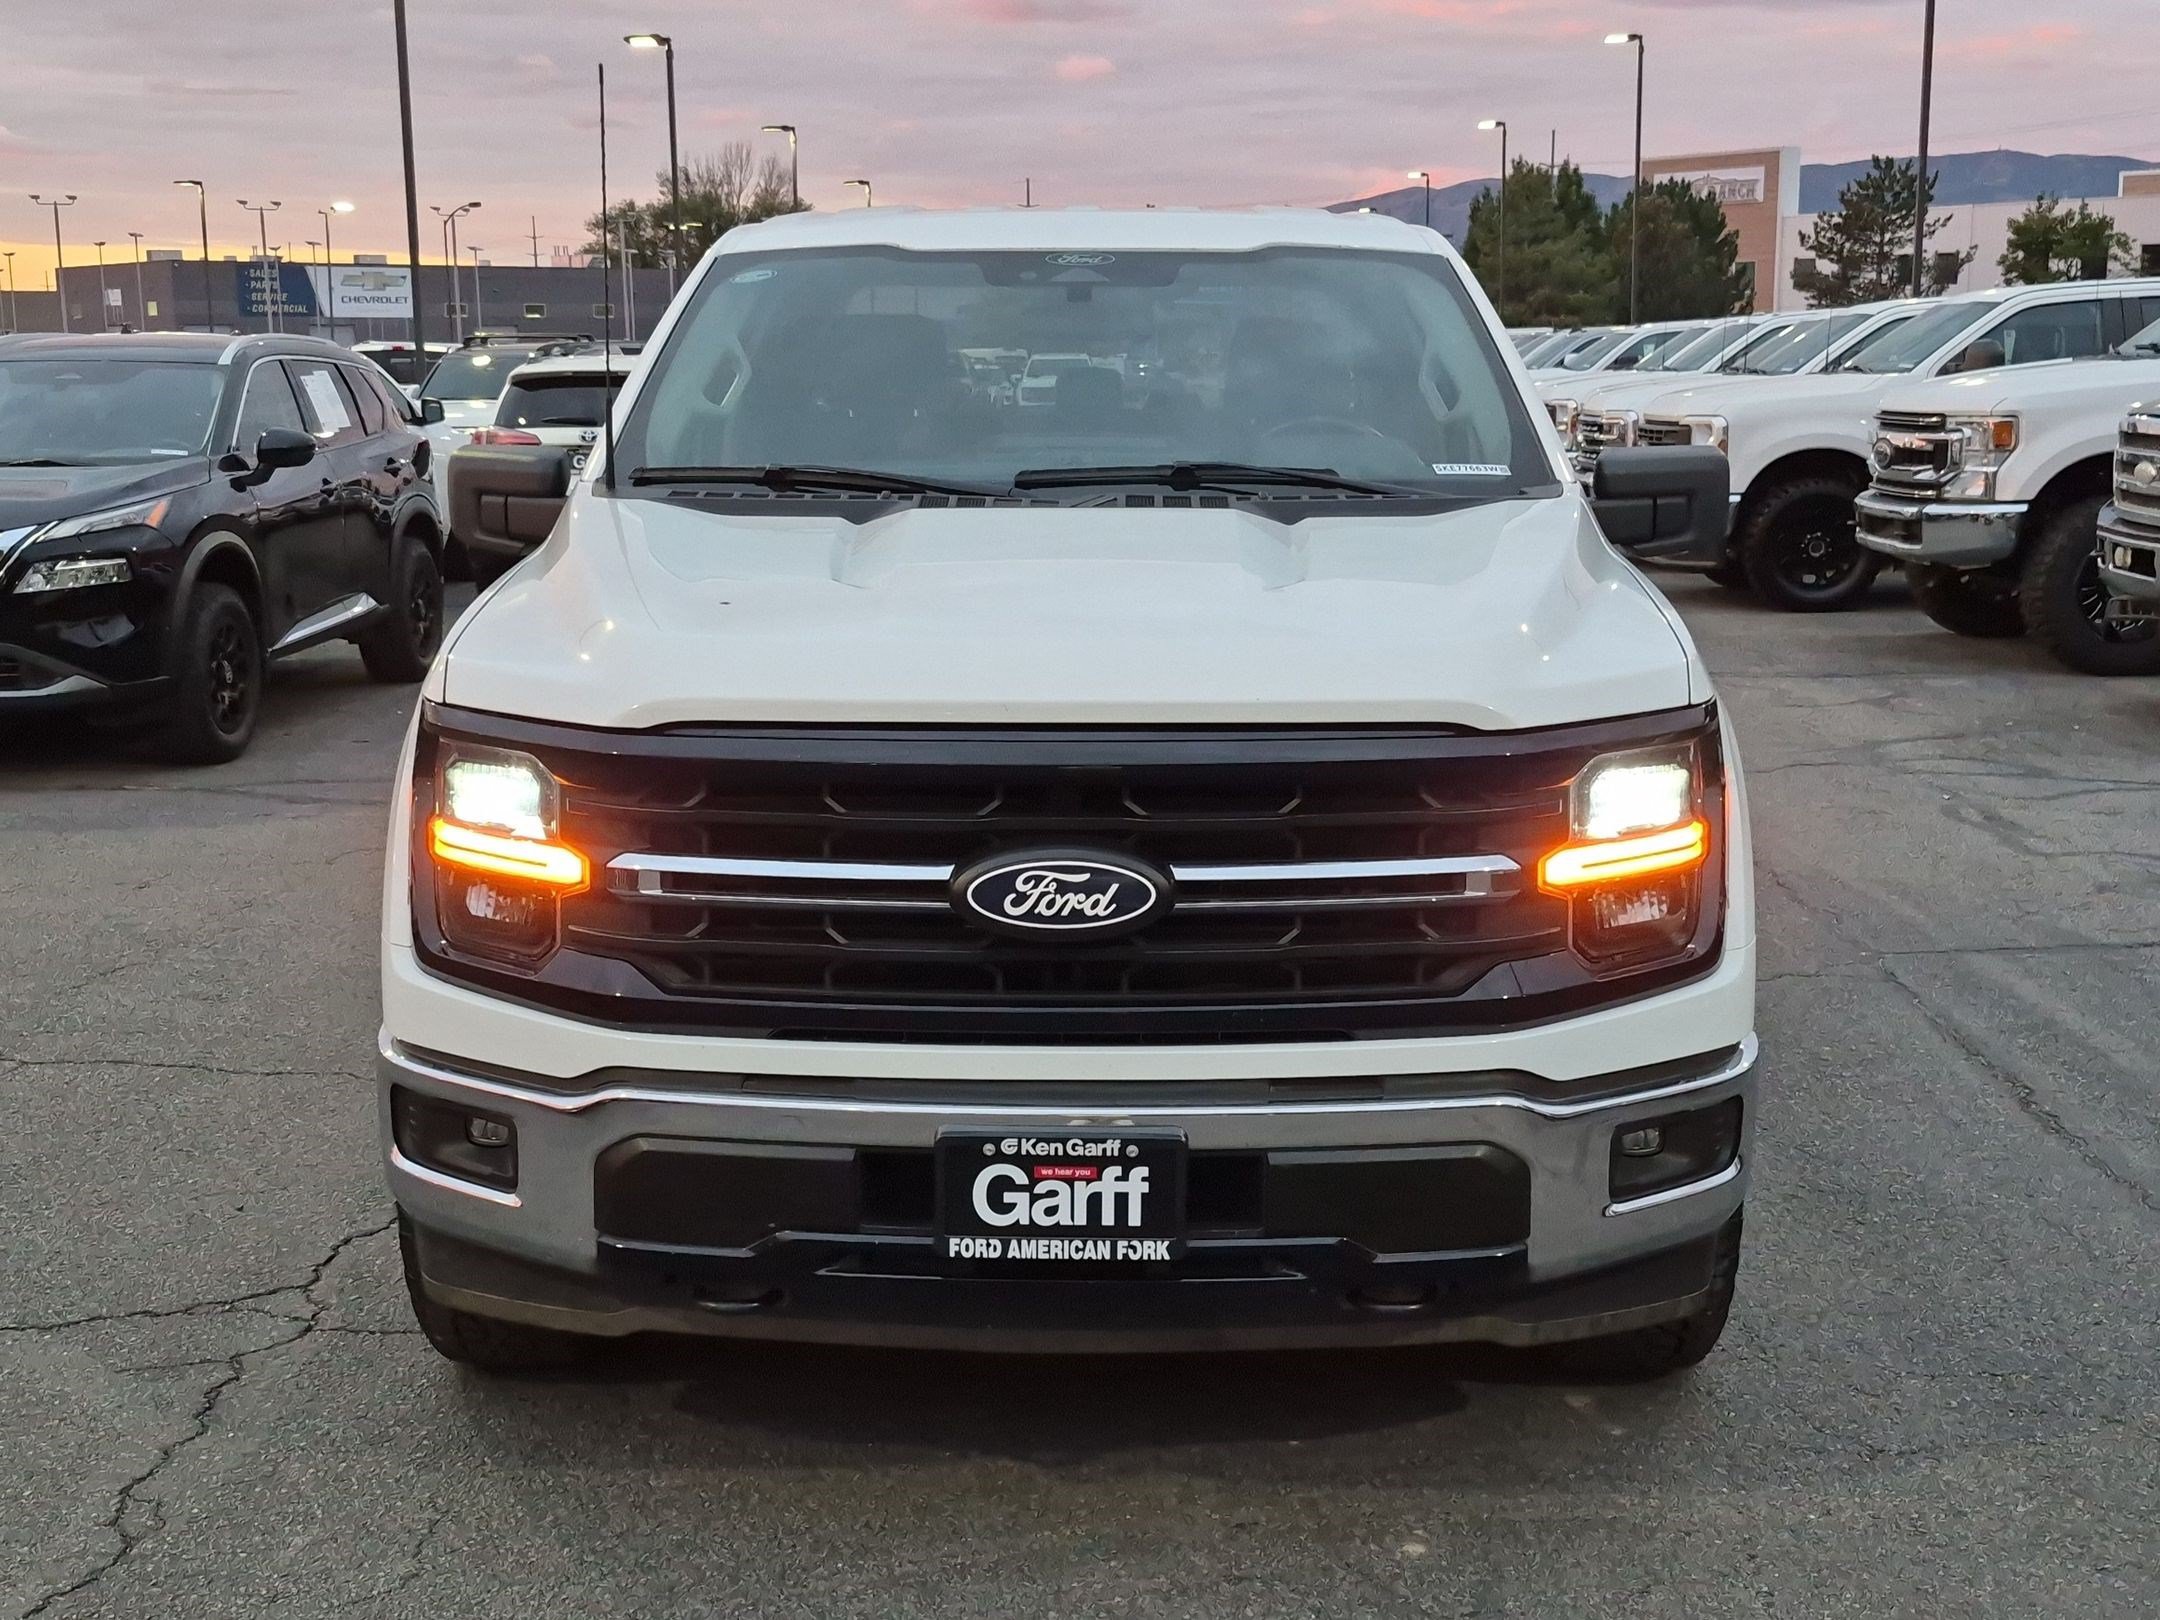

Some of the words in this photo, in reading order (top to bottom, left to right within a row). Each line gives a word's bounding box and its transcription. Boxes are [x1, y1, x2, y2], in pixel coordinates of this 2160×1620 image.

[1058, 254, 1103, 264] Ford
[249, 268, 278, 278] SALES
[341, 295, 409, 304] CHEVROLET
[1003, 870, 1120, 917] Ford
[1020, 1138, 1064, 1156] Ken
[1066, 1139, 1122, 1157] Garff
[1041, 1168, 1053, 1176] we
[1055, 1167, 1073, 1176] hear
[1075, 1169, 1091, 1178] you
[972, 1163, 1150, 1227] Garff
[949, 1238, 1002, 1259] FORD
[1007, 1239, 1111, 1260] AMERICAN
[1117, 1240, 1171, 1261] FORK
